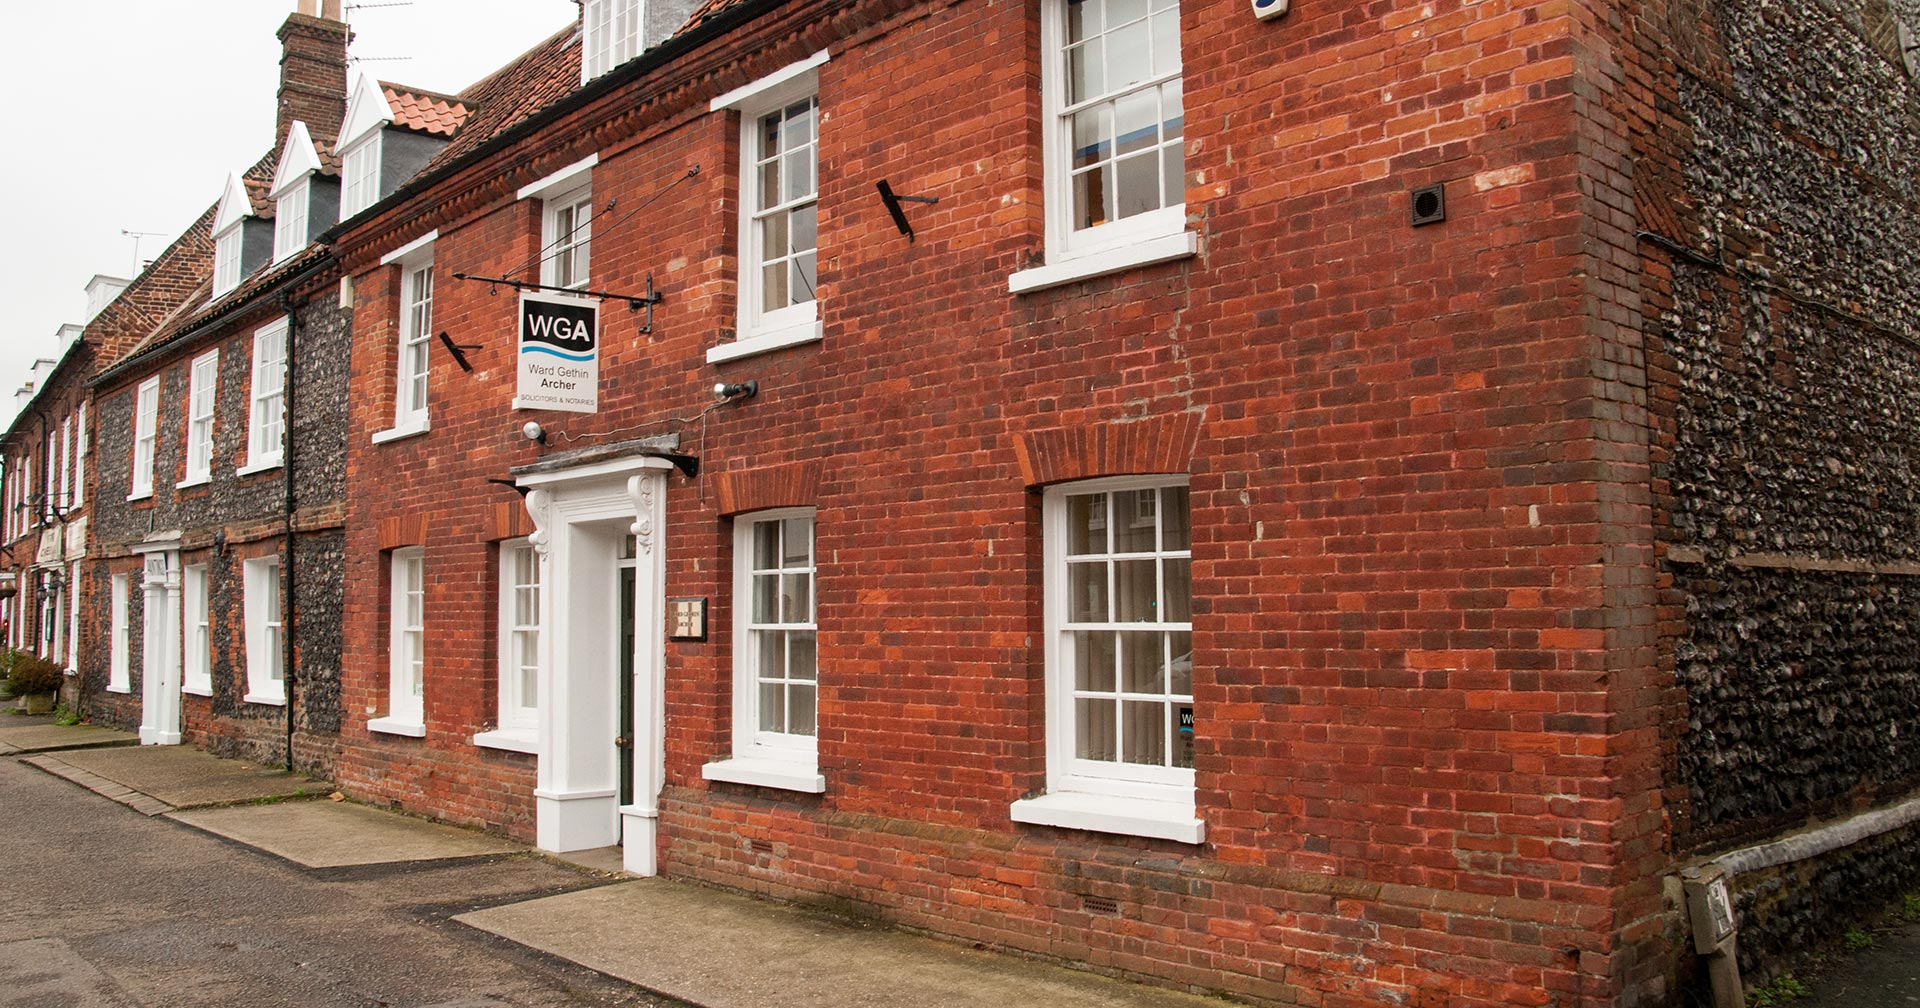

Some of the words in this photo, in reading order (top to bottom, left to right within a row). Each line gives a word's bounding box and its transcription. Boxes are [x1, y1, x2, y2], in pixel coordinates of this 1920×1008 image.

[528, 314, 590, 342] WGA
[528, 364, 554, 376] Ward
[557, 366, 589, 379] Gethin
[541, 379, 577, 390] Archer
[521, 394, 558, 403] SOLICITORS
[565, 398, 595, 406] NOTARIES
